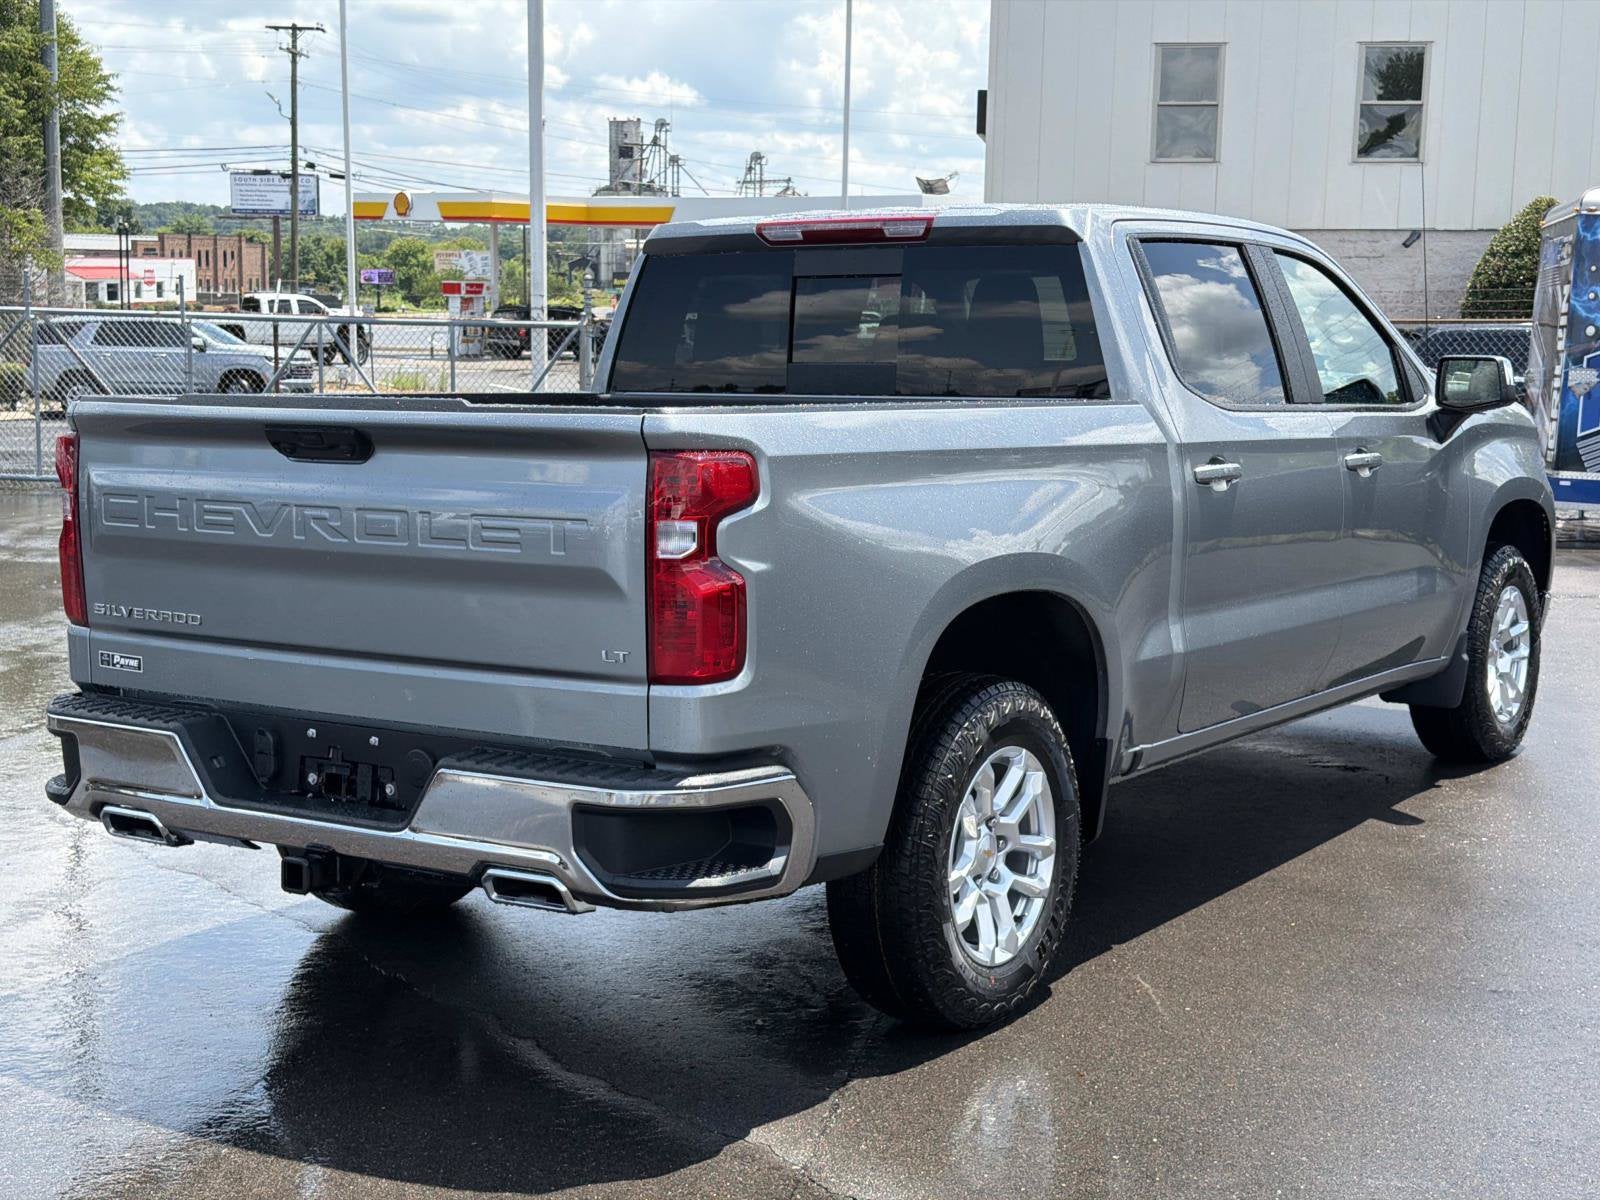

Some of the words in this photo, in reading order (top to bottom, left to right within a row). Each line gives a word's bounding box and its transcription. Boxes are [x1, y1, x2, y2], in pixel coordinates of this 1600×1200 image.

[102, 493, 588, 555] CHEVROLET
[94, 603, 202, 625] SILVERADO
[601, 650, 631, 664] LT
